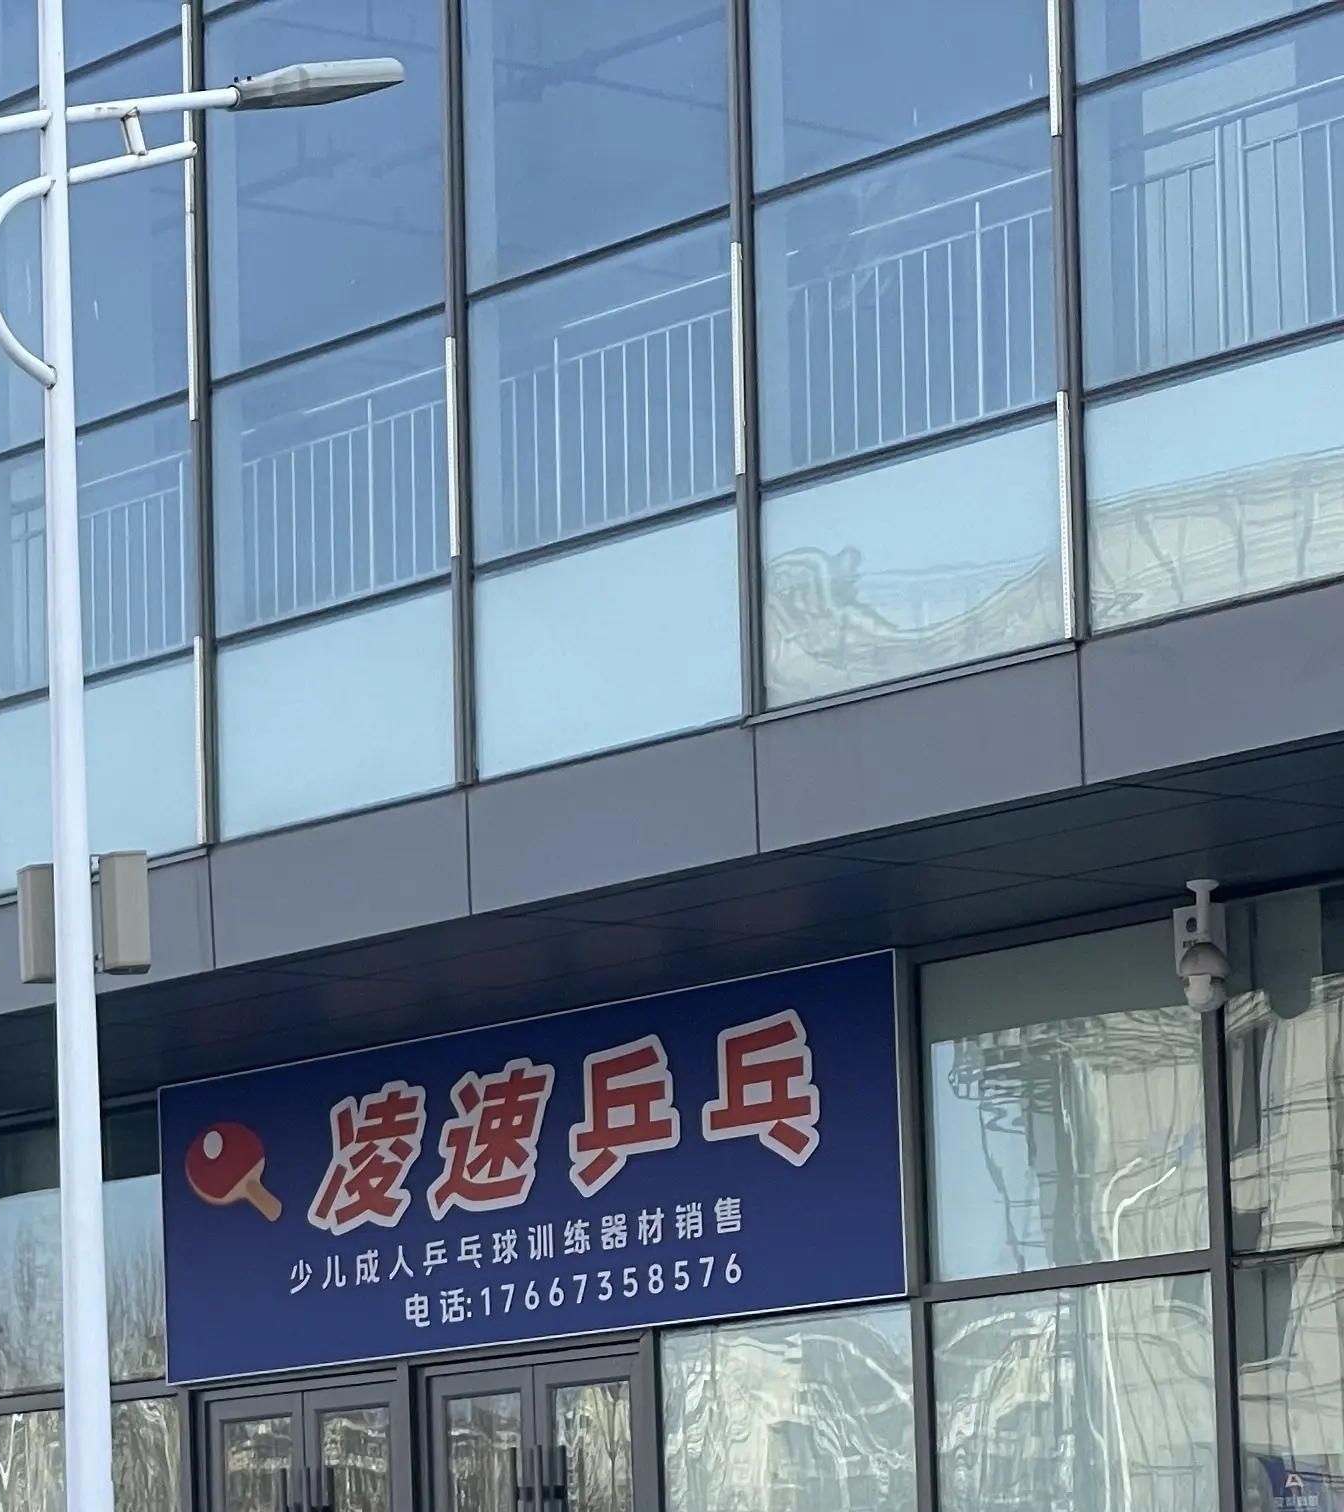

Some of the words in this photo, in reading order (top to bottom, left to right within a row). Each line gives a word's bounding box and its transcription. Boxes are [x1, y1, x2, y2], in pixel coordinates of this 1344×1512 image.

[308, 1009, 820, 1234] 凌速乒乓
[289, 1197, 743, 1294] 少儿成人乒乓球训练器材销售
